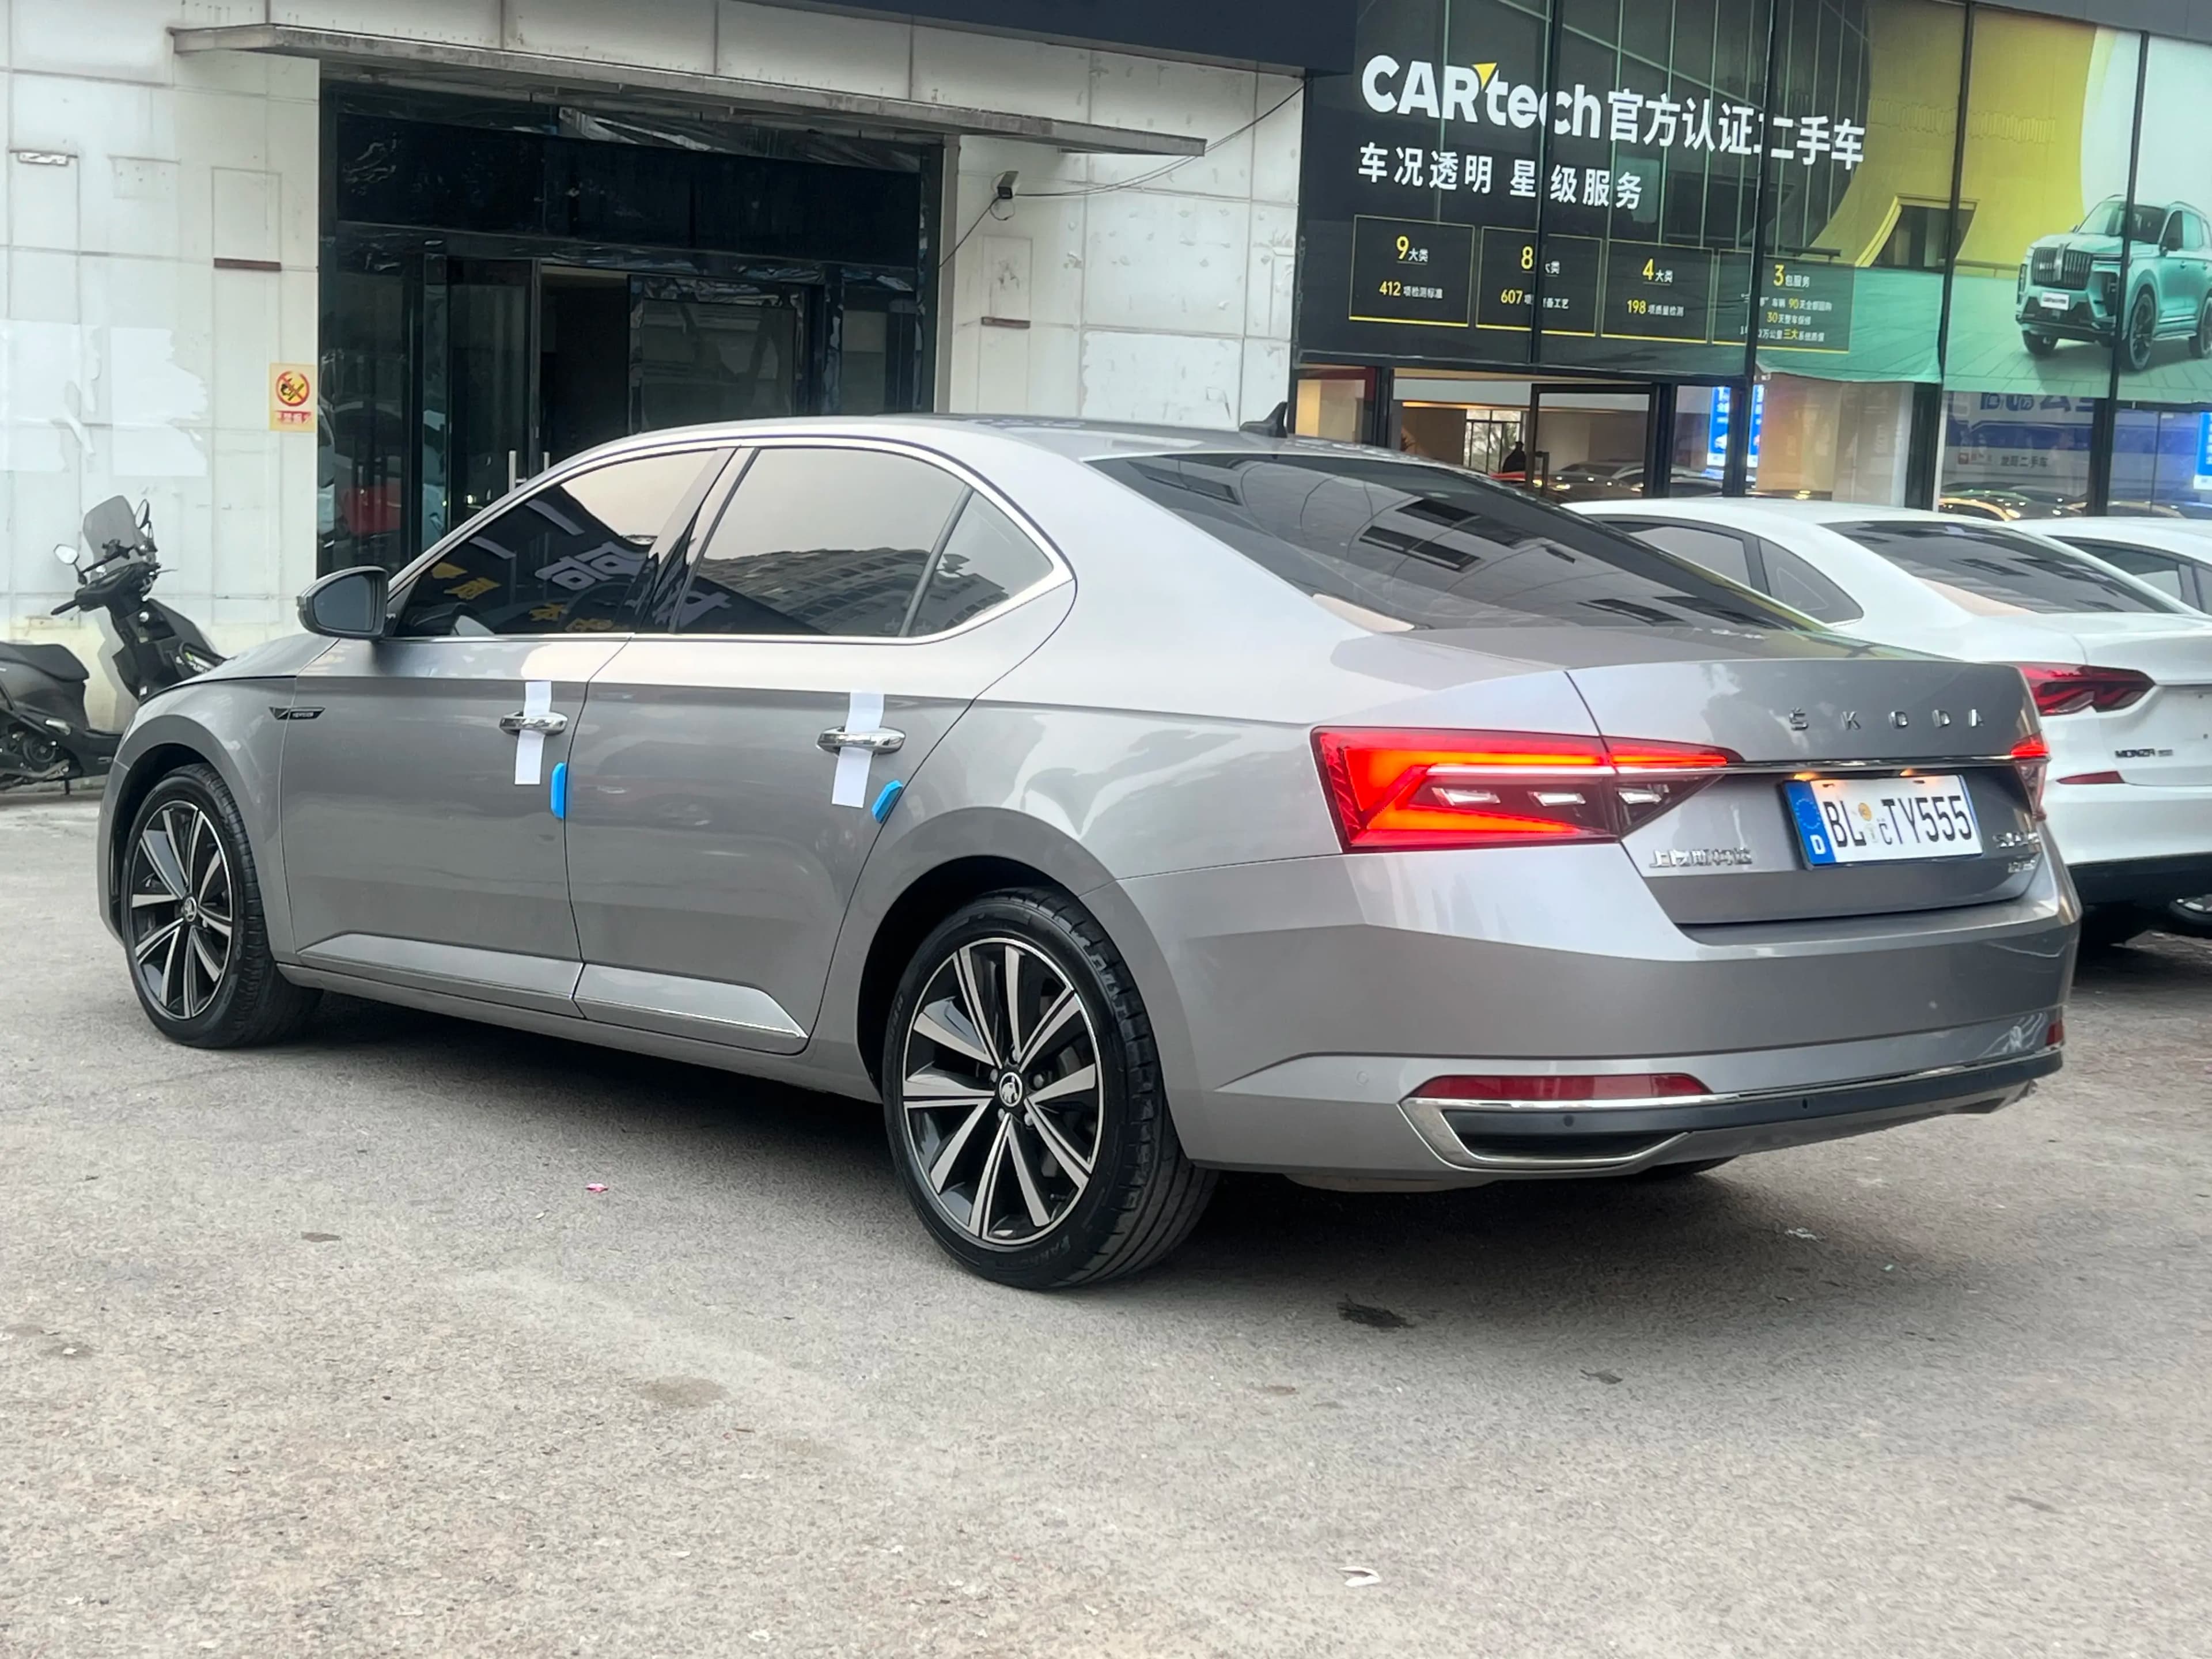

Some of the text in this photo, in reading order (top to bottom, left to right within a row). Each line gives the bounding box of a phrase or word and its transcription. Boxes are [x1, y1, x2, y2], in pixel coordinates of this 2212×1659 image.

[1358, 142, 1642, 210] 车况透明 星级服务
[1379, 281, 1401, 296] 412
[1501, 289, 1523, 304] 607
[1627, 300, 1646, 315] 198
